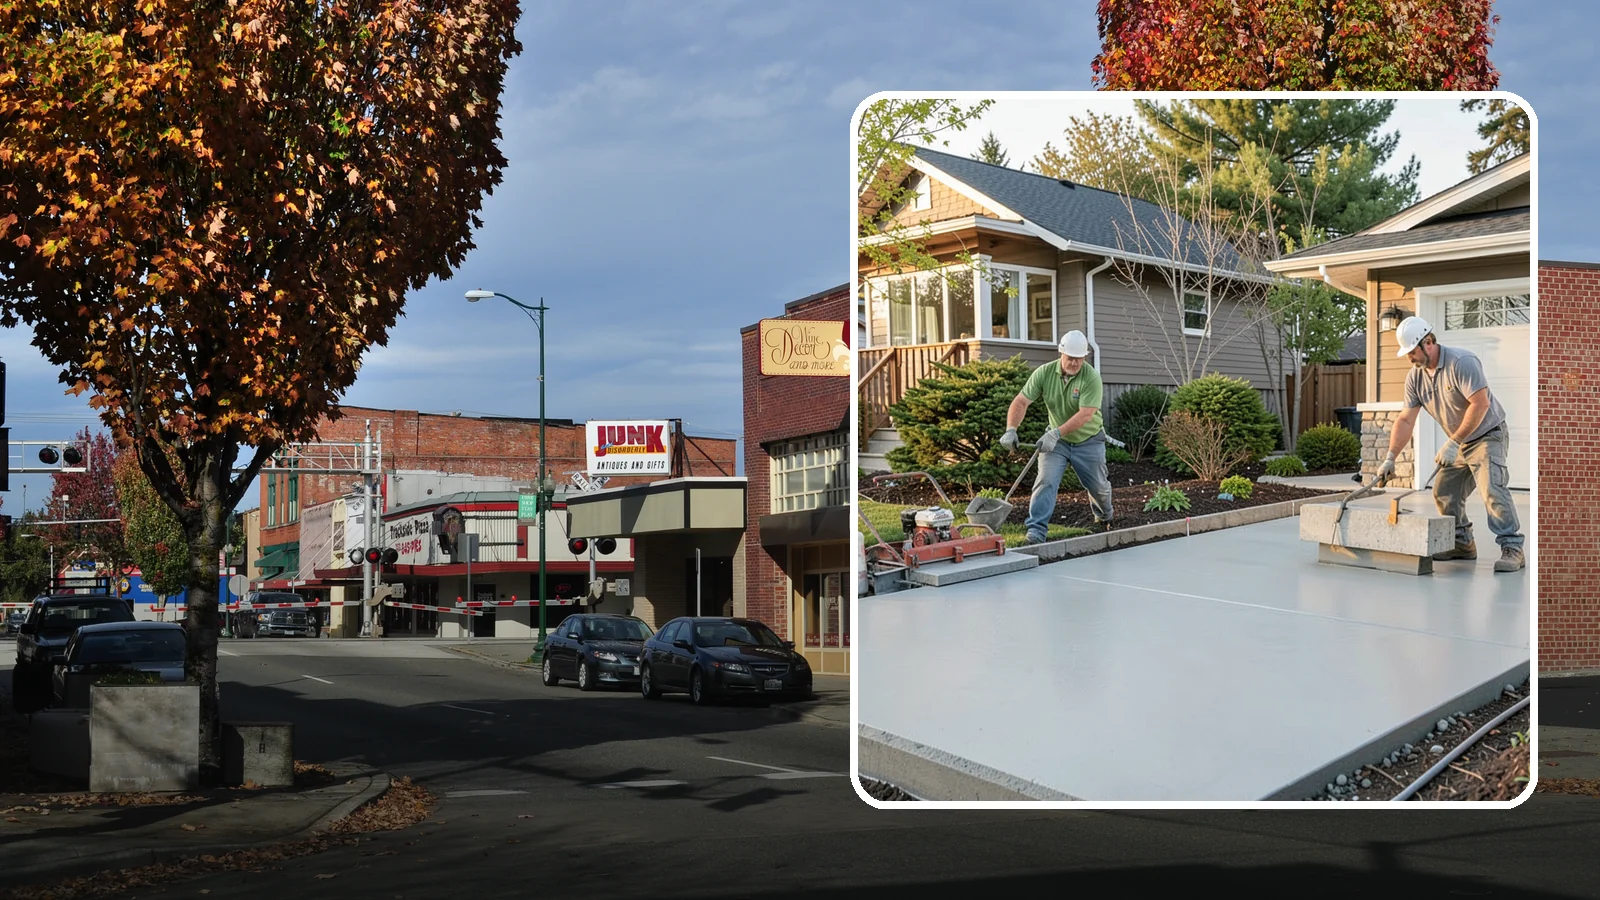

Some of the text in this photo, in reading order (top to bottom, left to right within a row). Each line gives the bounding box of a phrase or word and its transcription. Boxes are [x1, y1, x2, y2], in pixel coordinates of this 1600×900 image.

[595, 425, 664, 457] JUNK
[607, 446, 646, 454] DISORDERLY
[597, 460, 665, 470] ANTIQUES AND GIFTS
[573, 473, 589, 492] RAIL
[352, 498, 364, 511] CRO
[390, 519, 429, 540] Trackside Pizza
